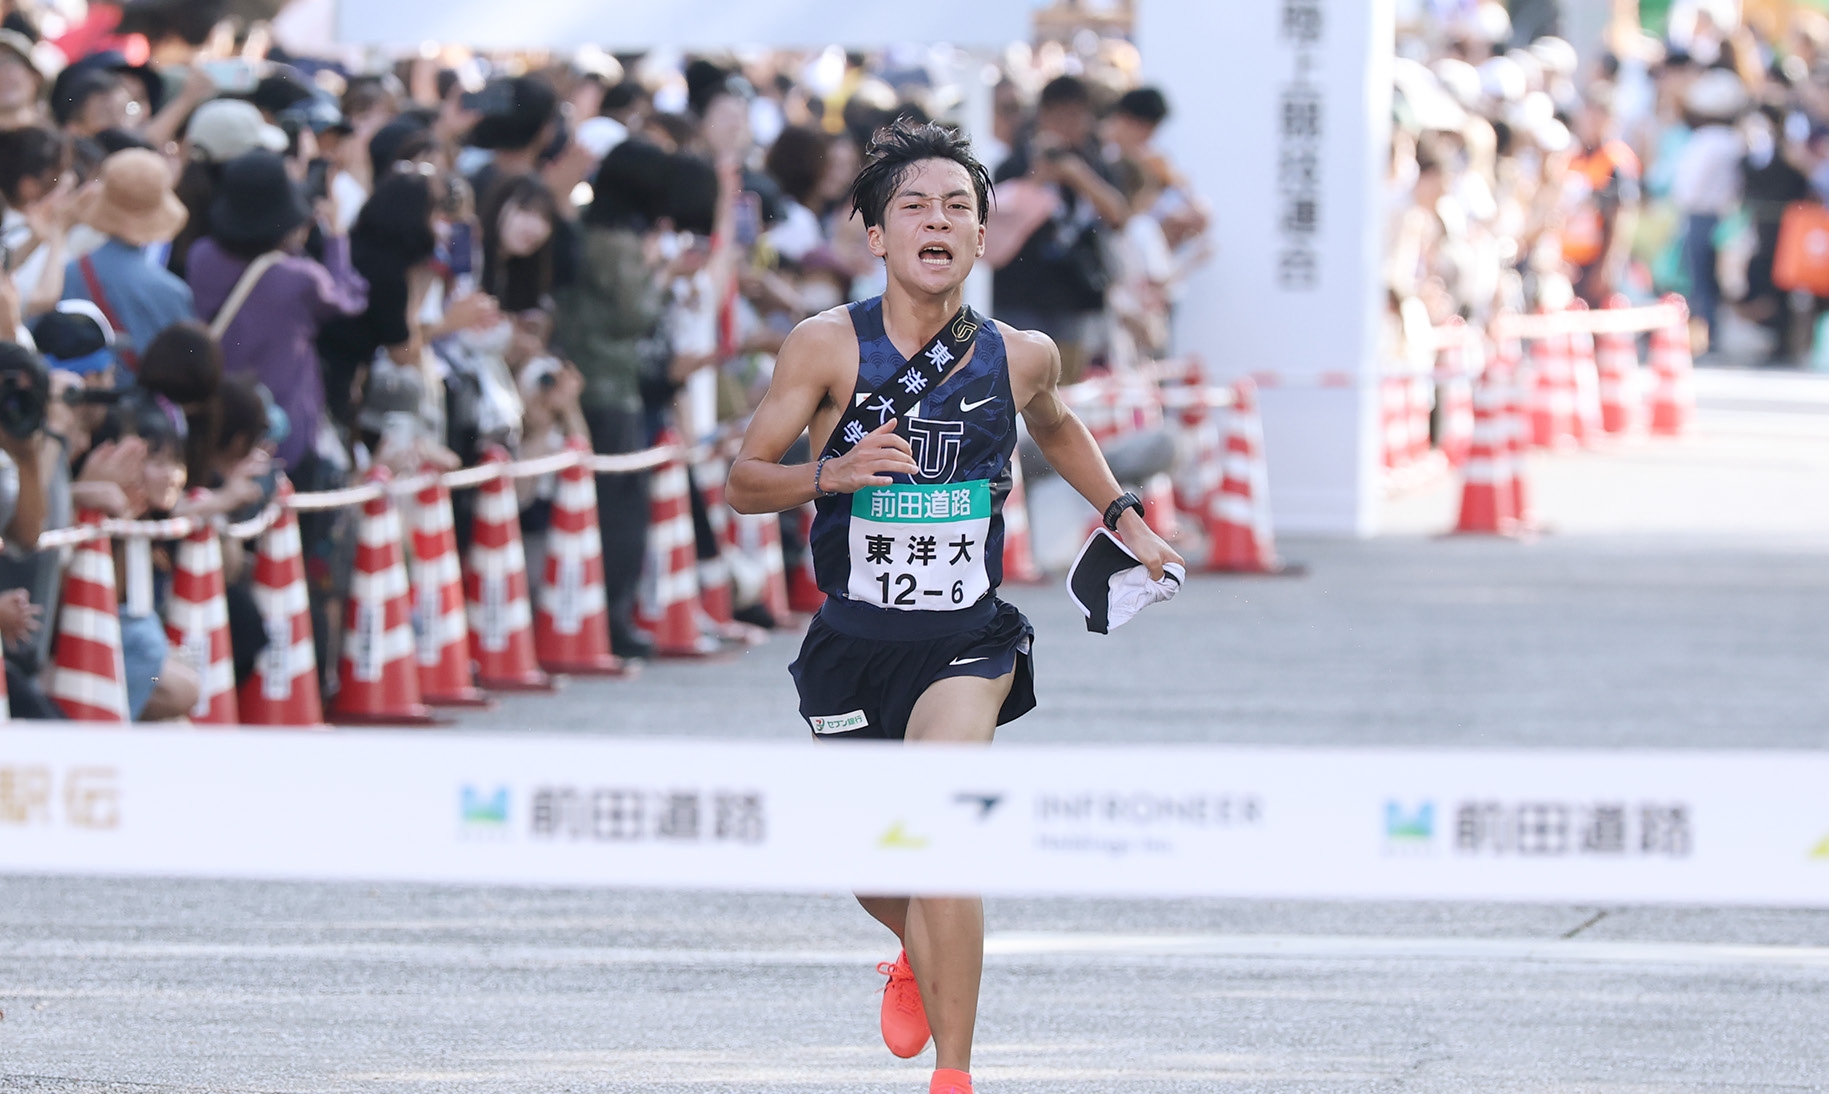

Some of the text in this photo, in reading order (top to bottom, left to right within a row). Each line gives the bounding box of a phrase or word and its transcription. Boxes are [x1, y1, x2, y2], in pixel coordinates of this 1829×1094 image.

[843, 339, 955, 446] 東洋大学
[870, 488, 972, 519] 前田道路
[865, 534, 975, 566] 東洋大
[875, 572, 965, 605] 12-6
[827, 715, 863, 729] セブン銀行
[530, 787, 766, 843] 前田道路
[1036, 794, 1263, 825] INFRONEER
[1454, 801, 1692, 856] 前田道路
